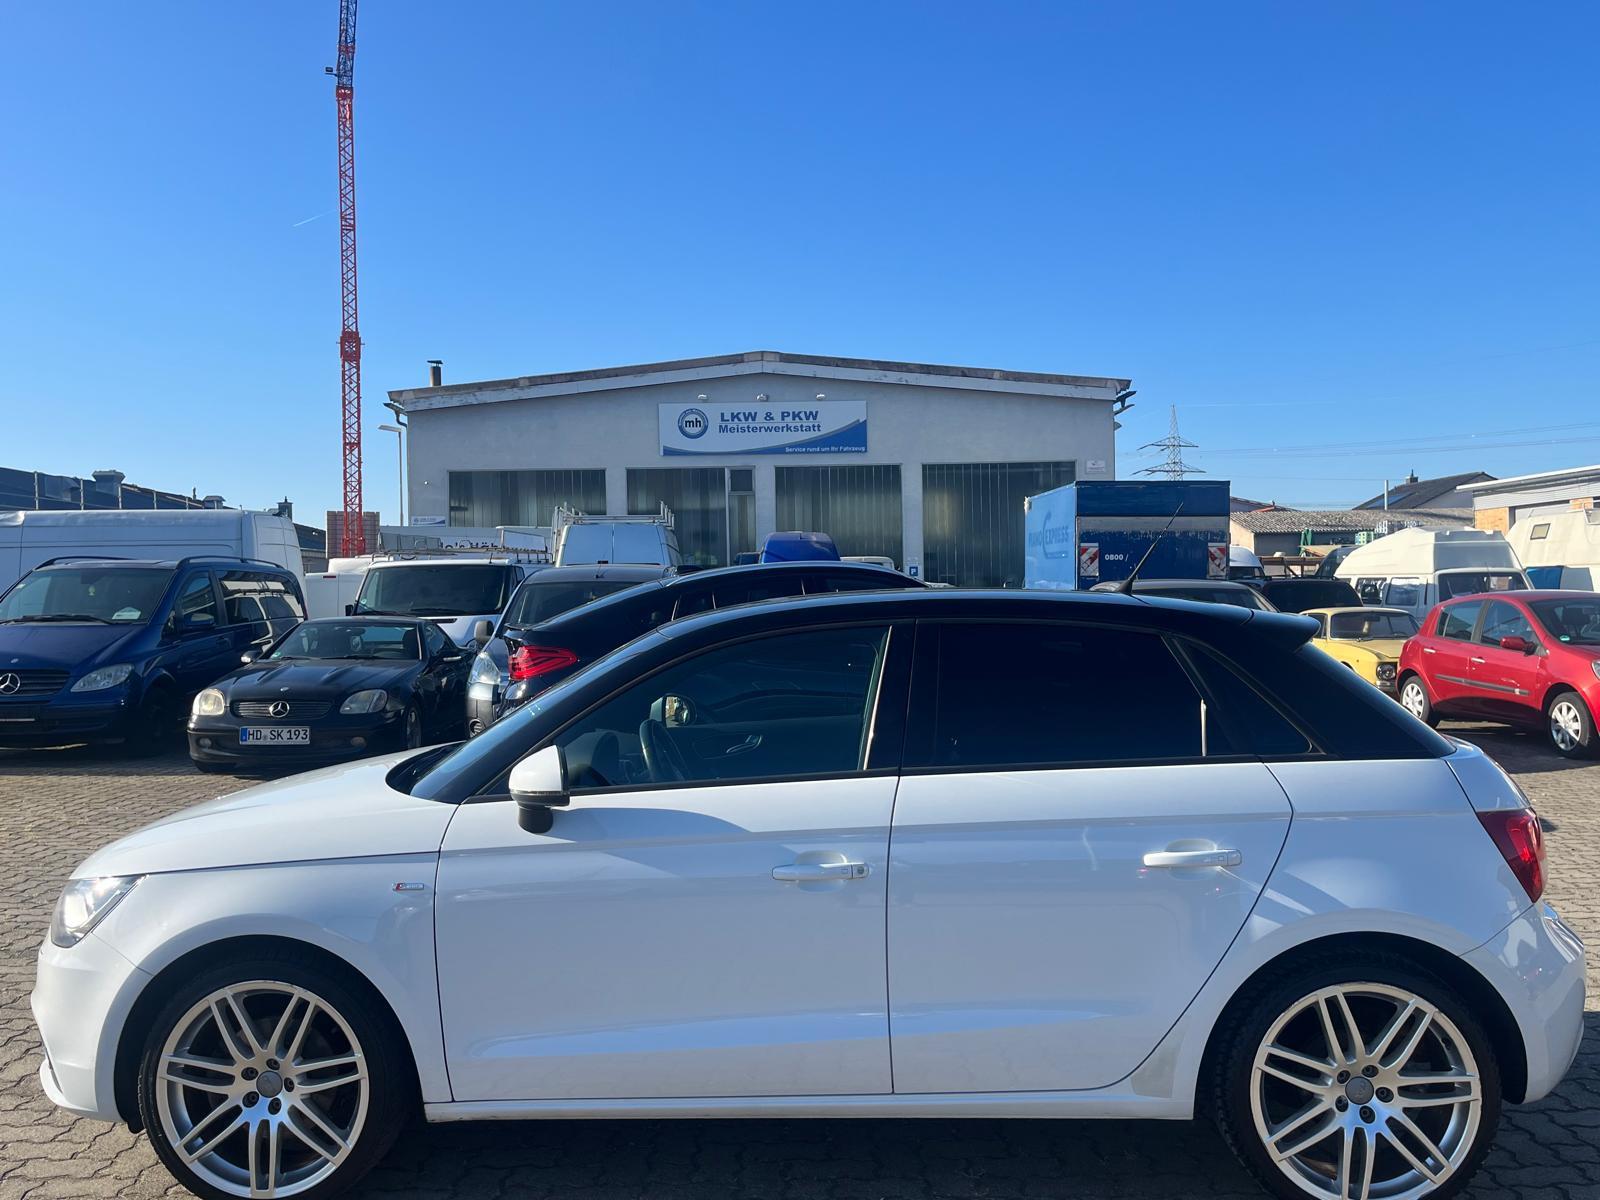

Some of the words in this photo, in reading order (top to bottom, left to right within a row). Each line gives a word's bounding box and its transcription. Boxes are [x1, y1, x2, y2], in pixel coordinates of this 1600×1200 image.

[720, 411, 758, 422] LKW
[764, 411, 775, 421] &
[780, 410, 819, 421] PKW
[685, 417, 702, 428] mh
[718, 423, 822, 433] Meisterwerkstatt
[1104, 553, 1124, 561] 0800
[248, 729, 262, 740] HD
[269, 729, 284, 740] SK
[286, 729, 308, 740] 193
